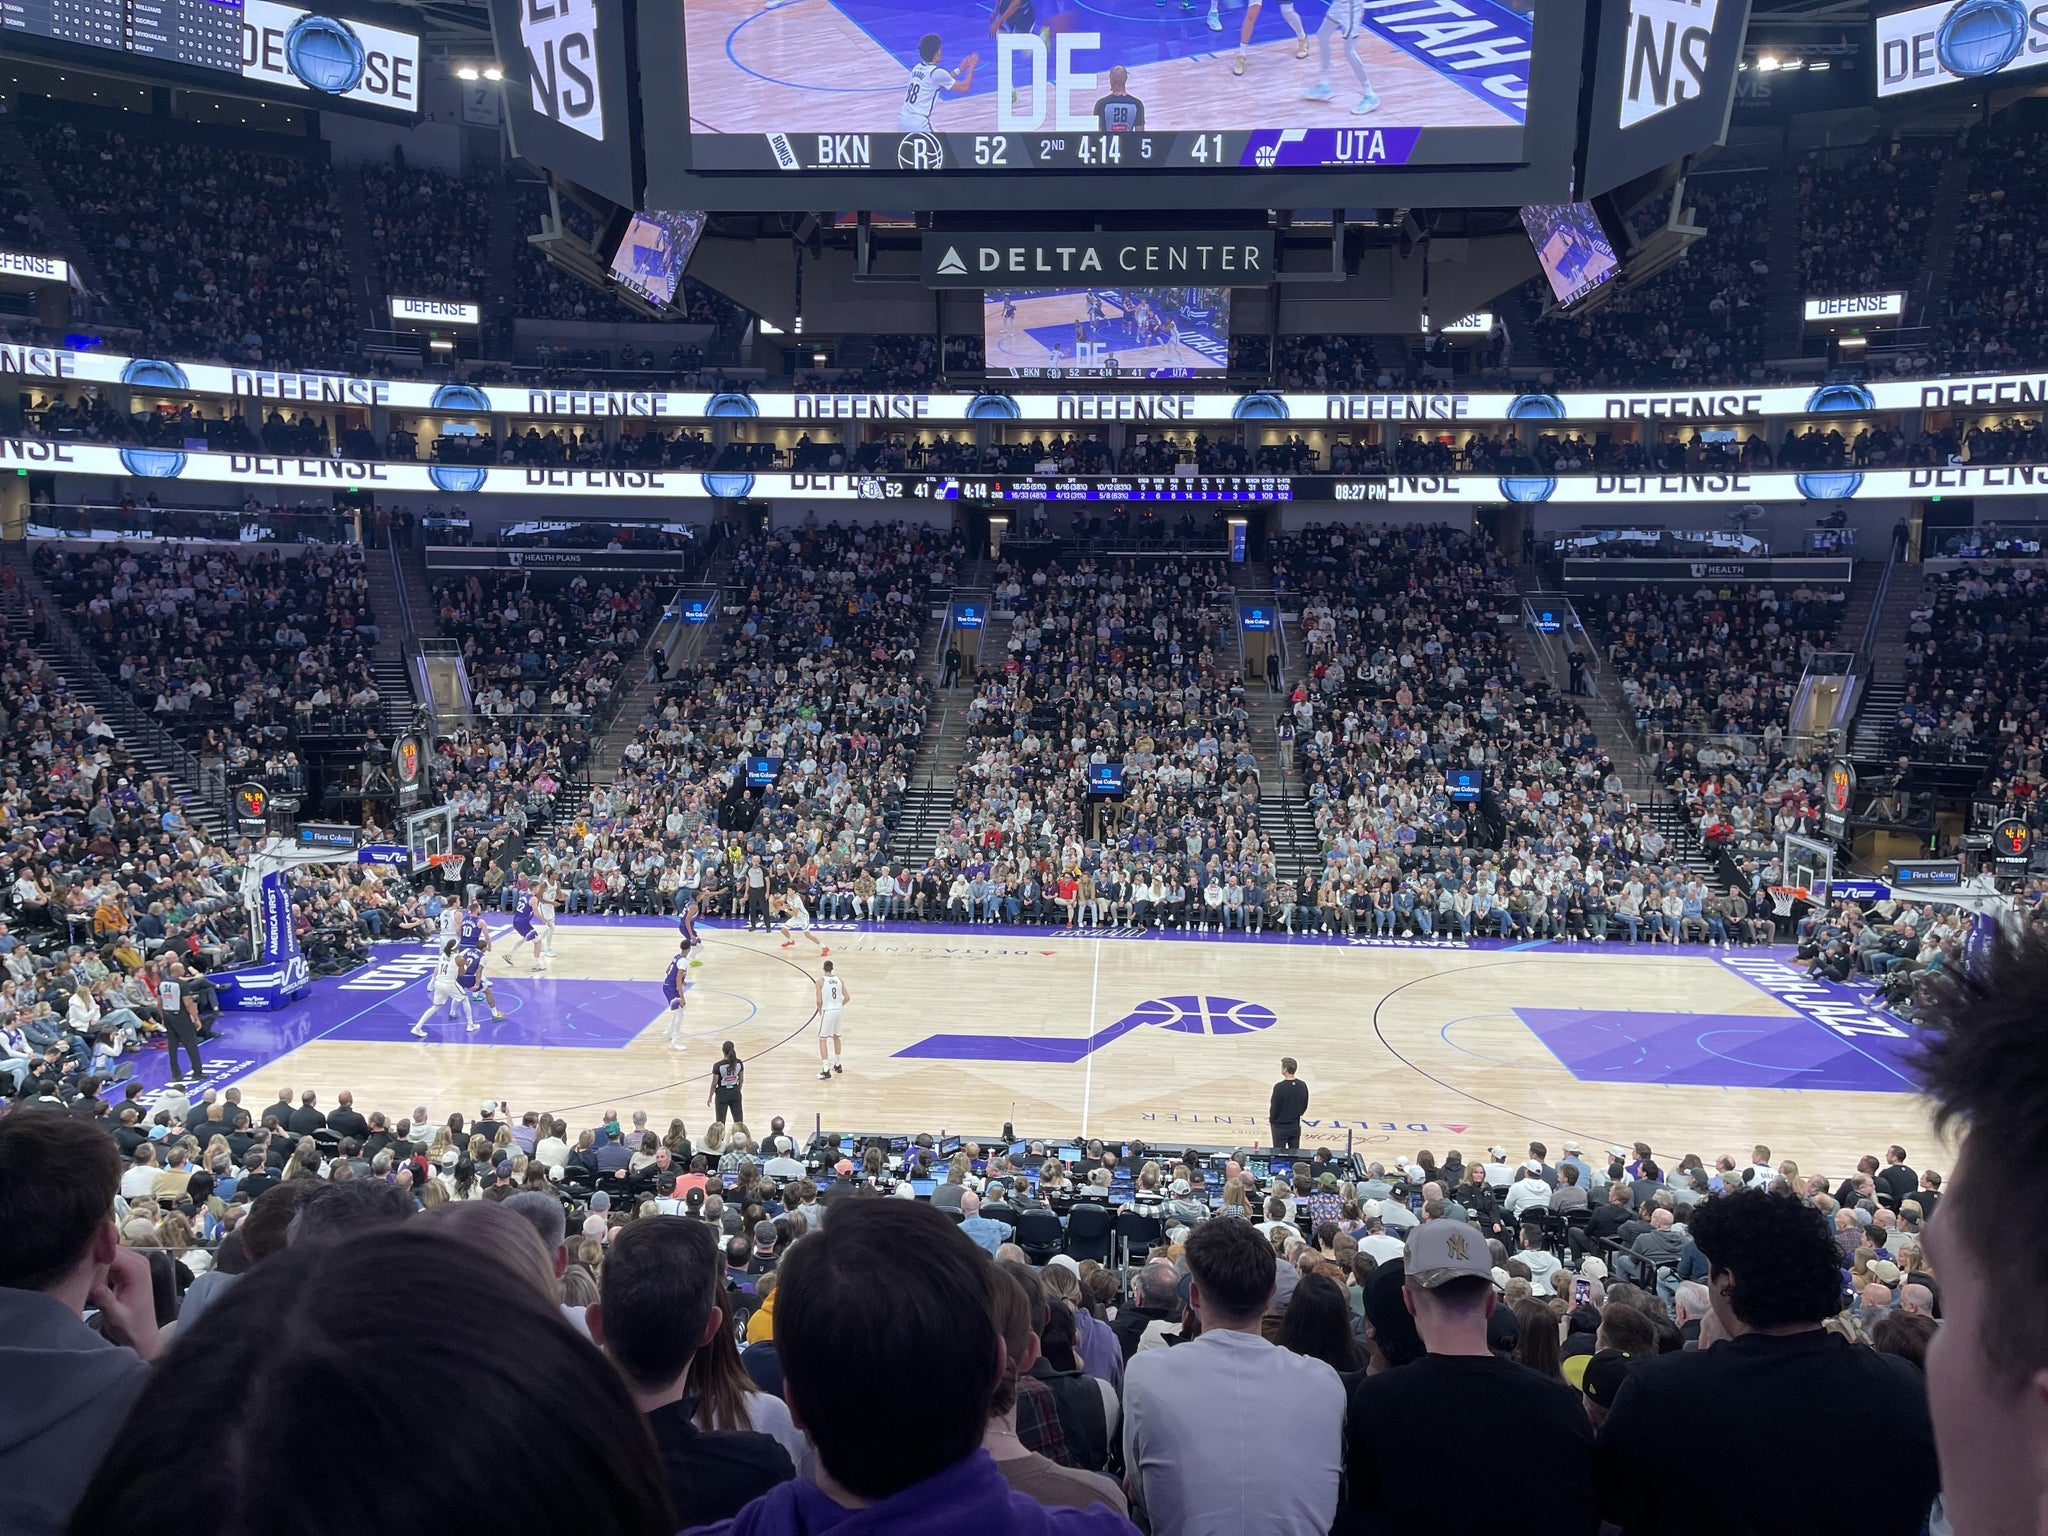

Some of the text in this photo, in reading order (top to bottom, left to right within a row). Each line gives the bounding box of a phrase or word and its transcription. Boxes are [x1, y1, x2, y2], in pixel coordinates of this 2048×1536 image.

[998, 32, 1101, 132] DE
[772, 134, 793, 167] BONUS
[818, 135, 869, 163] BKN
[975, 136, 1007, 164] 52
[1040, 135, 1152, 163] 2ND 4:14 5
[1191, 135, 1222, 163] 41
[1336, 130, 1386, 160] UTA
[979, 246, 1260, 271] DELTA CENTER
[1023, 368, 1040, 377] BKN
[1069, 368, 1079, 377] 52
[1132, 368, 1142, 377] 41
[1172, 367, 1188, 377] UTA
[886, 483, 902, 497] 52
[914, 483, 929, 497] 41
[964, 483, 987, 498] 4:14
[1335, 485, 1387, 499] 08:27 PM
[244, 793, 263, 801] 4:14
[251, 801, 261, 813] 5
[314, 833, 353, 844] First Colony
[2005, 829, 2026, 839] 4:14
[2012, 839, 2021, 851] 5
[1913, 871, 1957, 881] First Colony
[516, 902, 525, 913] 22
[268, 888, 278, 955] AMERICA FIRST
[280, 888, 294, 952] AMERICA FIRST
[462, 925, 473, 938] 10
[1346, 938, 1469, 948] SEATGEEK
[832, 987, 836, 1000] 8
[1721, 957, 1910, 1038] UTAH JAZZ
[1142, 1112, 1428, 1132] DELTA ENTER
